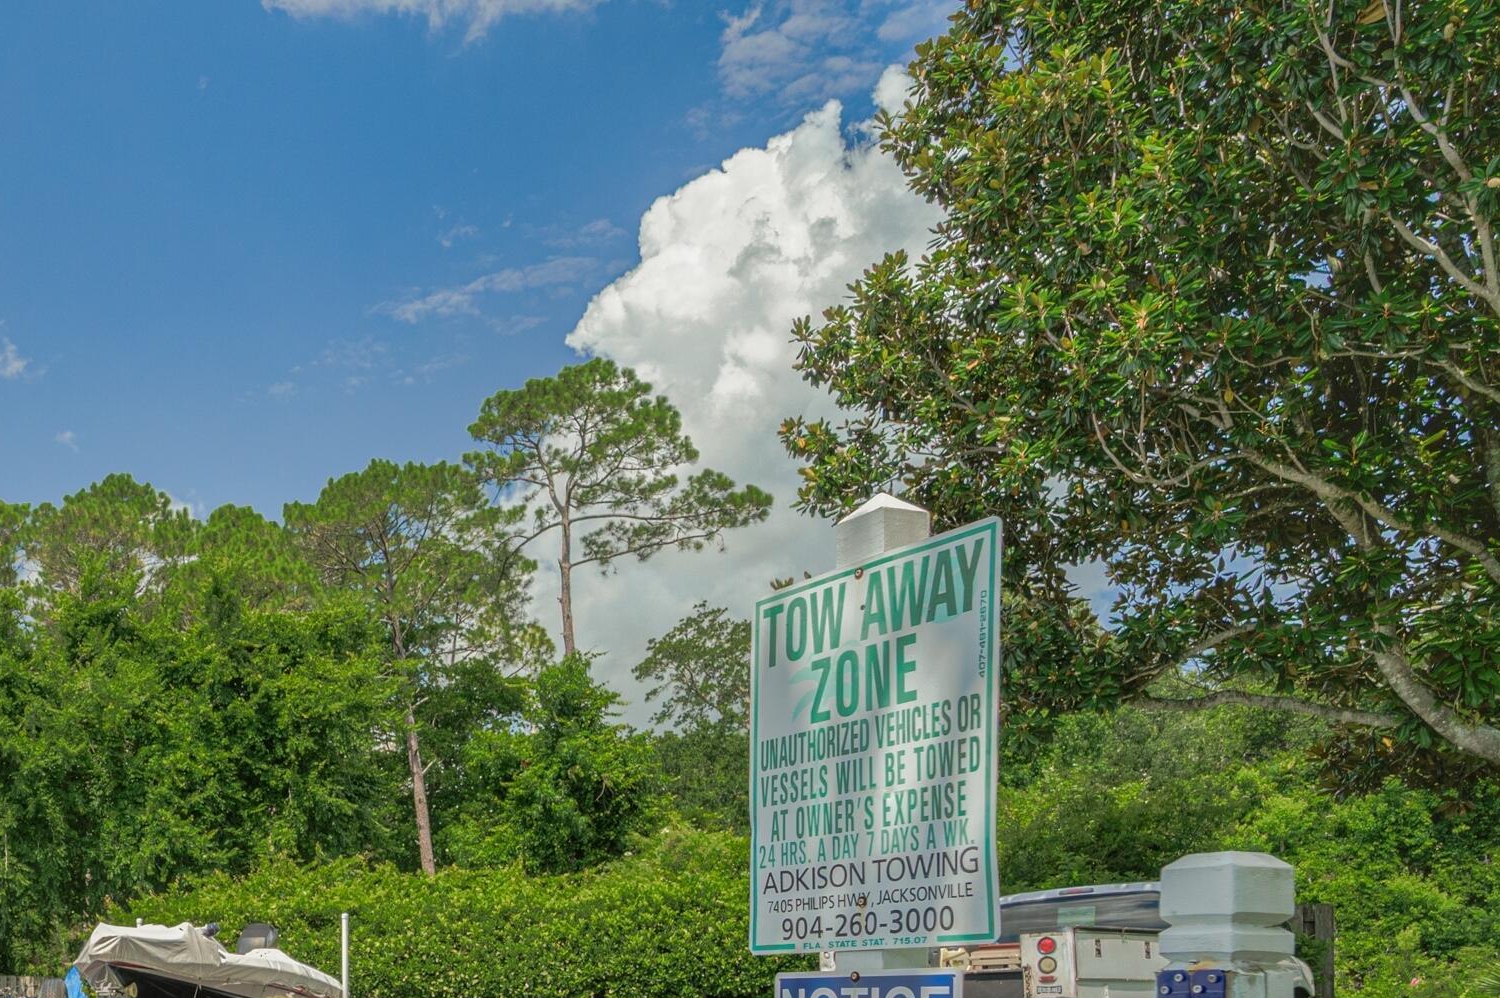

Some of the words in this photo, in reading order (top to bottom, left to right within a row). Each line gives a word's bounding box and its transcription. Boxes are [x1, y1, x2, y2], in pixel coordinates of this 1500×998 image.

[764, 582, 848, 668] TOW
[861, 539, 984, 641] AWAY
[810, 634, 917, 724] ZONE
[761, 719, 870, 772] UNAUTHORIZED
[875, 700, 952, 747] VEHICLES
[958, 693, 981, 731] OR
[761, 764, 827, 807] VESSELS
[836, 757, 876, 794] WILL
[885, 751, 905, 787] BE
[915, 736, 980, 781] TOWED
[771, 809, 790, 842] AT
[796, 795, 874, 837] OWNER'S
[882, 780, 967, 827] EXPENSE
[759, 844, 776, 868] 24
[781, 839, 812, 866] HRS.
[817, 838, 826, 862] A
[832, 834, 859, 860] DAY
[867, 832, 875, 856] 7
[881, 826, 919, 855] DAYS
[926, 823, 936, 850] A
[944, 818, 975, 846] WK.
[763, 855, 866, 895] ADKISON
[872, 846, 979, 883] TOWING
[767, 899, 793, 914] 7405
[795, 894, 835, 911] PHILIPS
[876, 882, 974, 906] JACKSONVILLE
[782, 906, 954, 941] 904-260-3000
[828, 940, 857, 948] STATE
[893, 937, 927, 945] 715.07
